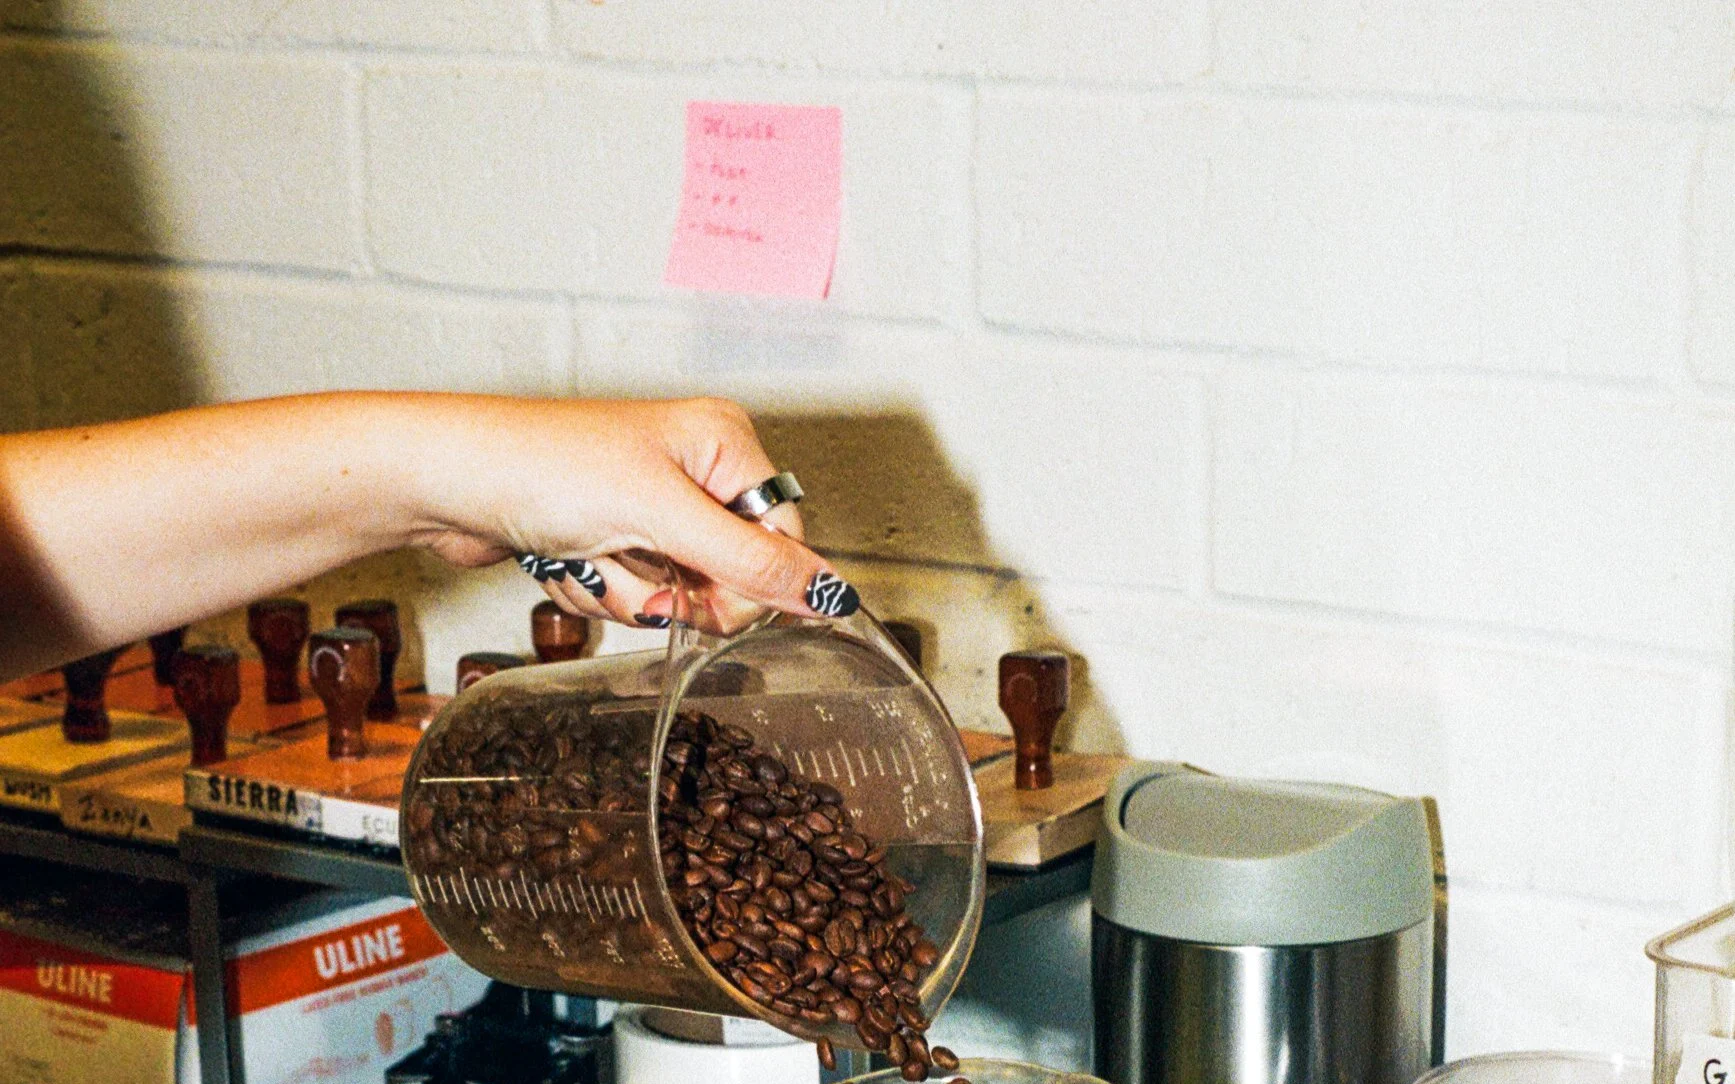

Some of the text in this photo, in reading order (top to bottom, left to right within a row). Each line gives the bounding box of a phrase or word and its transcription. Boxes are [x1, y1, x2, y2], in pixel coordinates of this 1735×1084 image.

[208, 775, 298, 815] SIERRA
[312, 924, 406, 979] ULINE
[36, 959, 114, 1004] ULINE
